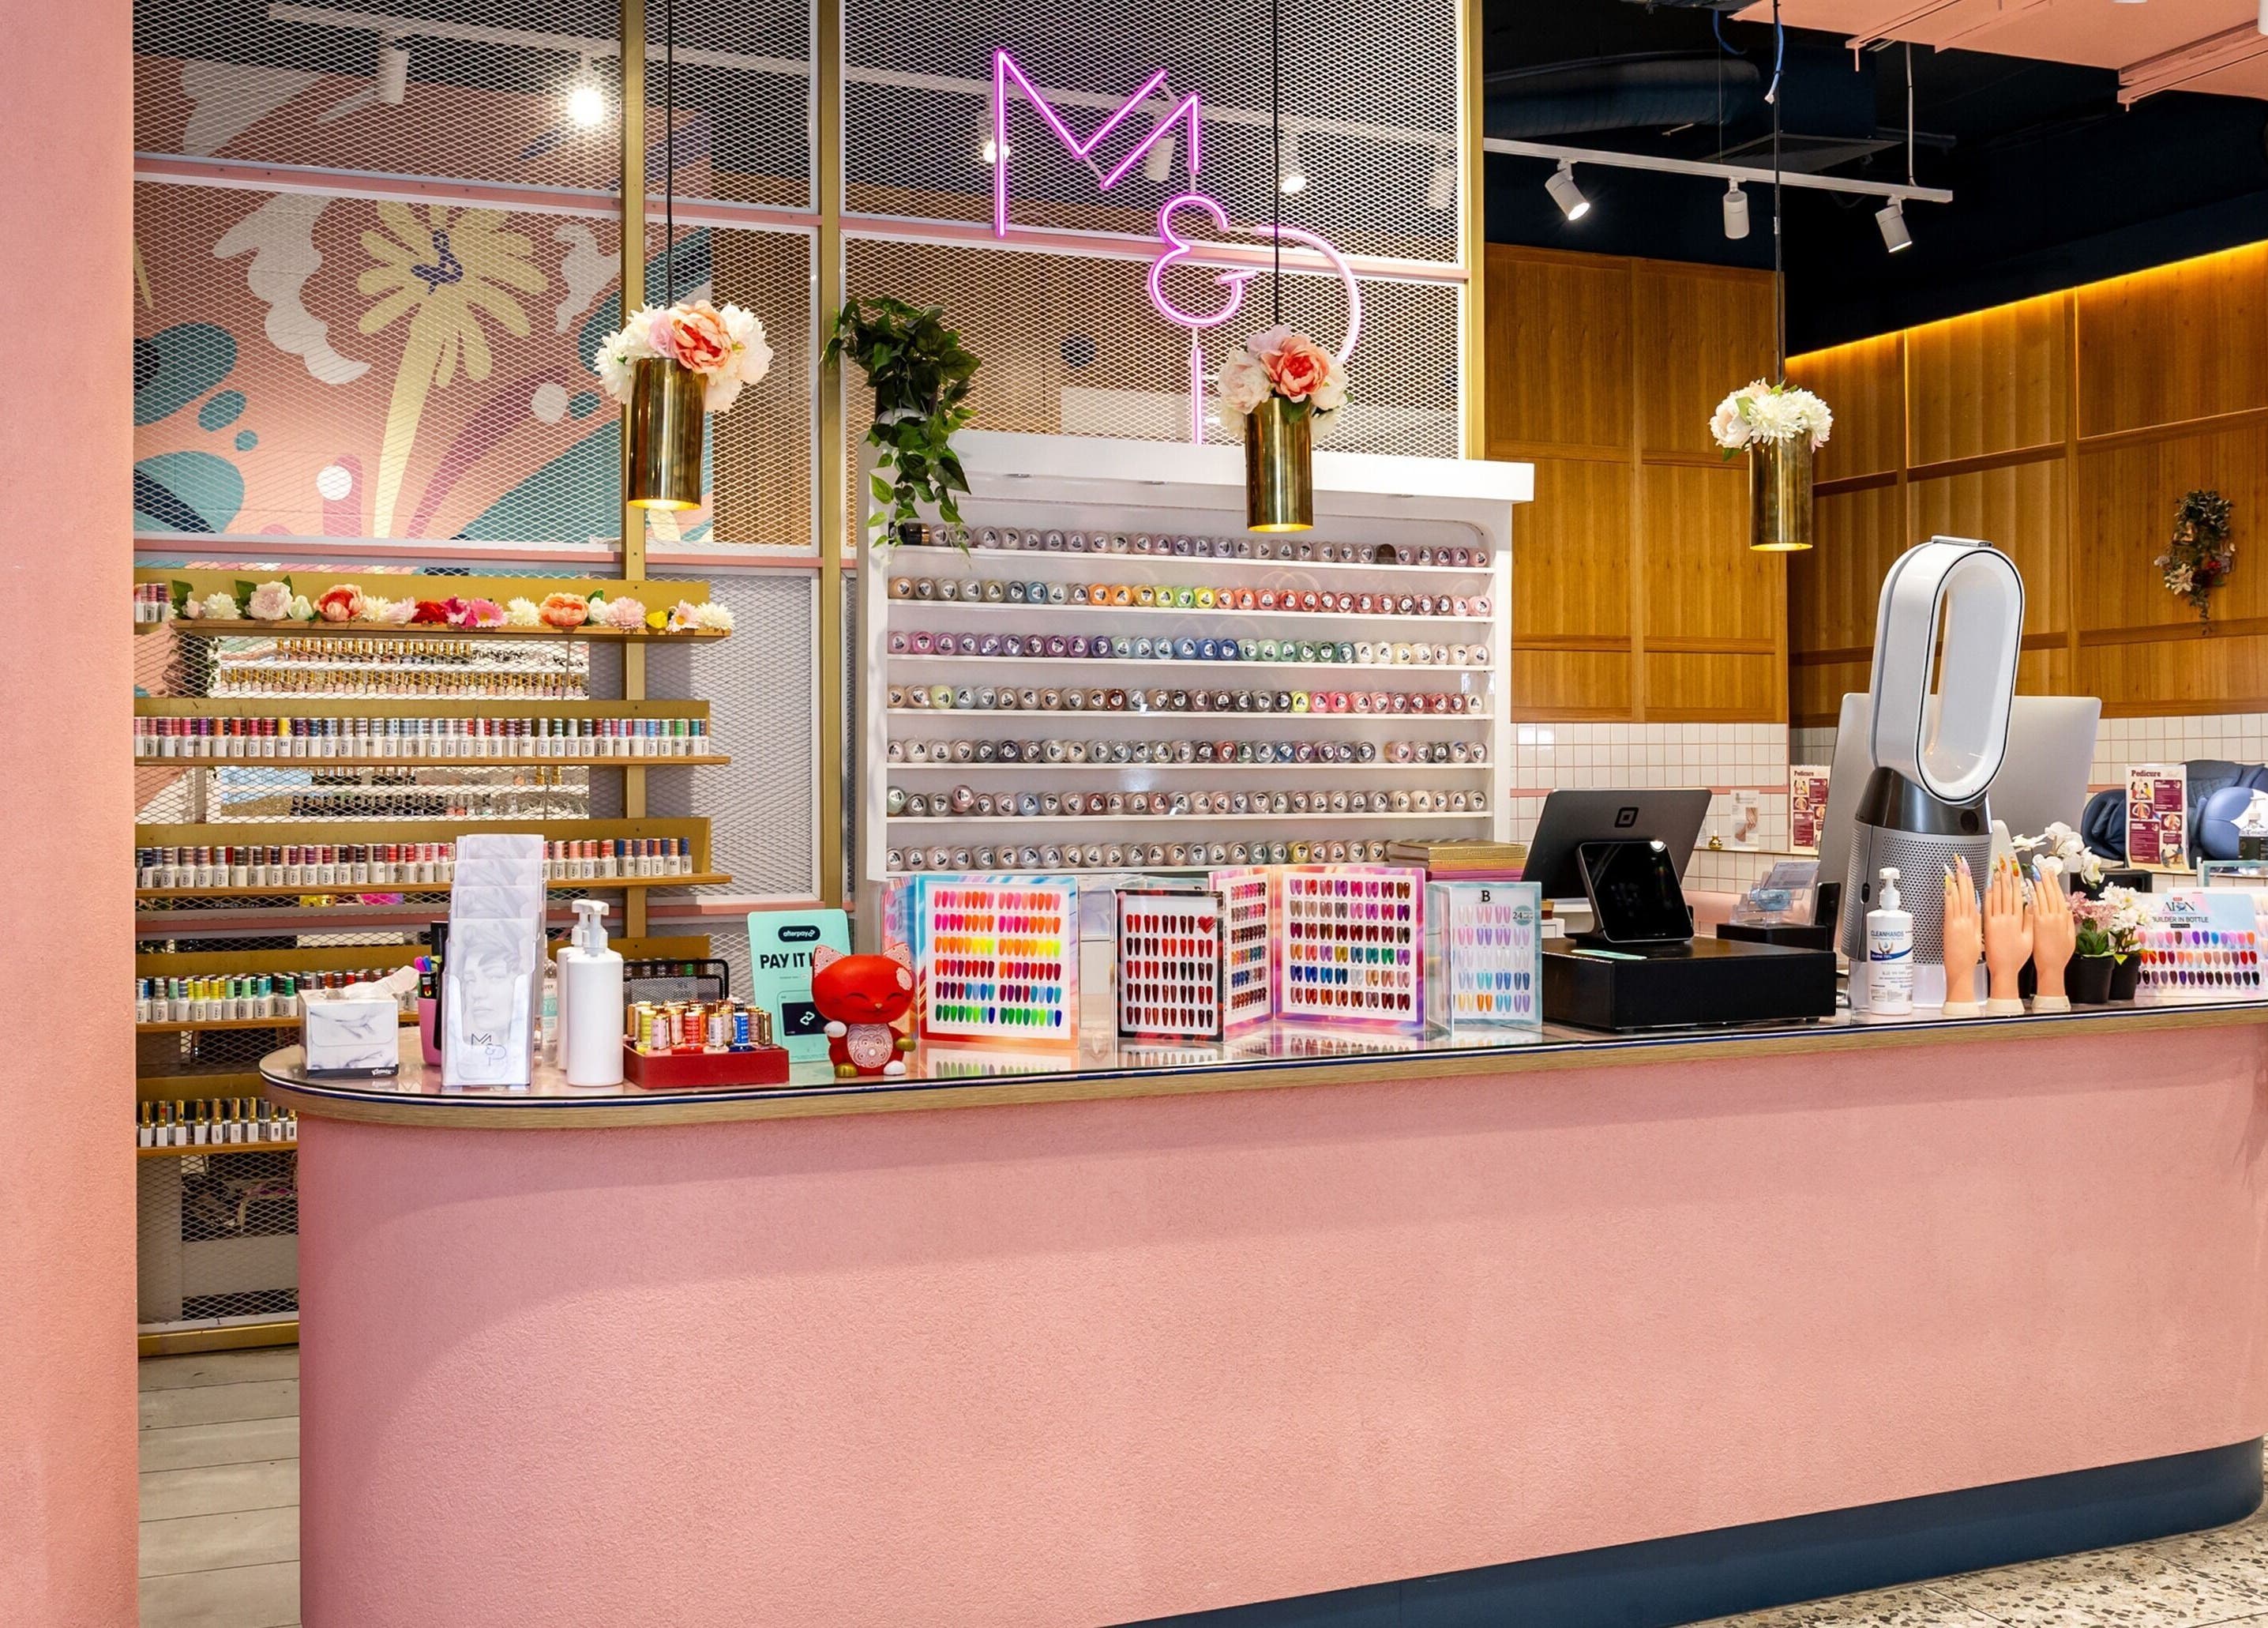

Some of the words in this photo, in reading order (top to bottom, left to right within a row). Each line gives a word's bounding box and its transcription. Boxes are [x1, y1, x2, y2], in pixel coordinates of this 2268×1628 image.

[1481, 889, 1491, 902] B
[783, 930, 809, 938] afterpay
[760, 953, 790, 969] PAY
[793, 953, 805, 968] IT
